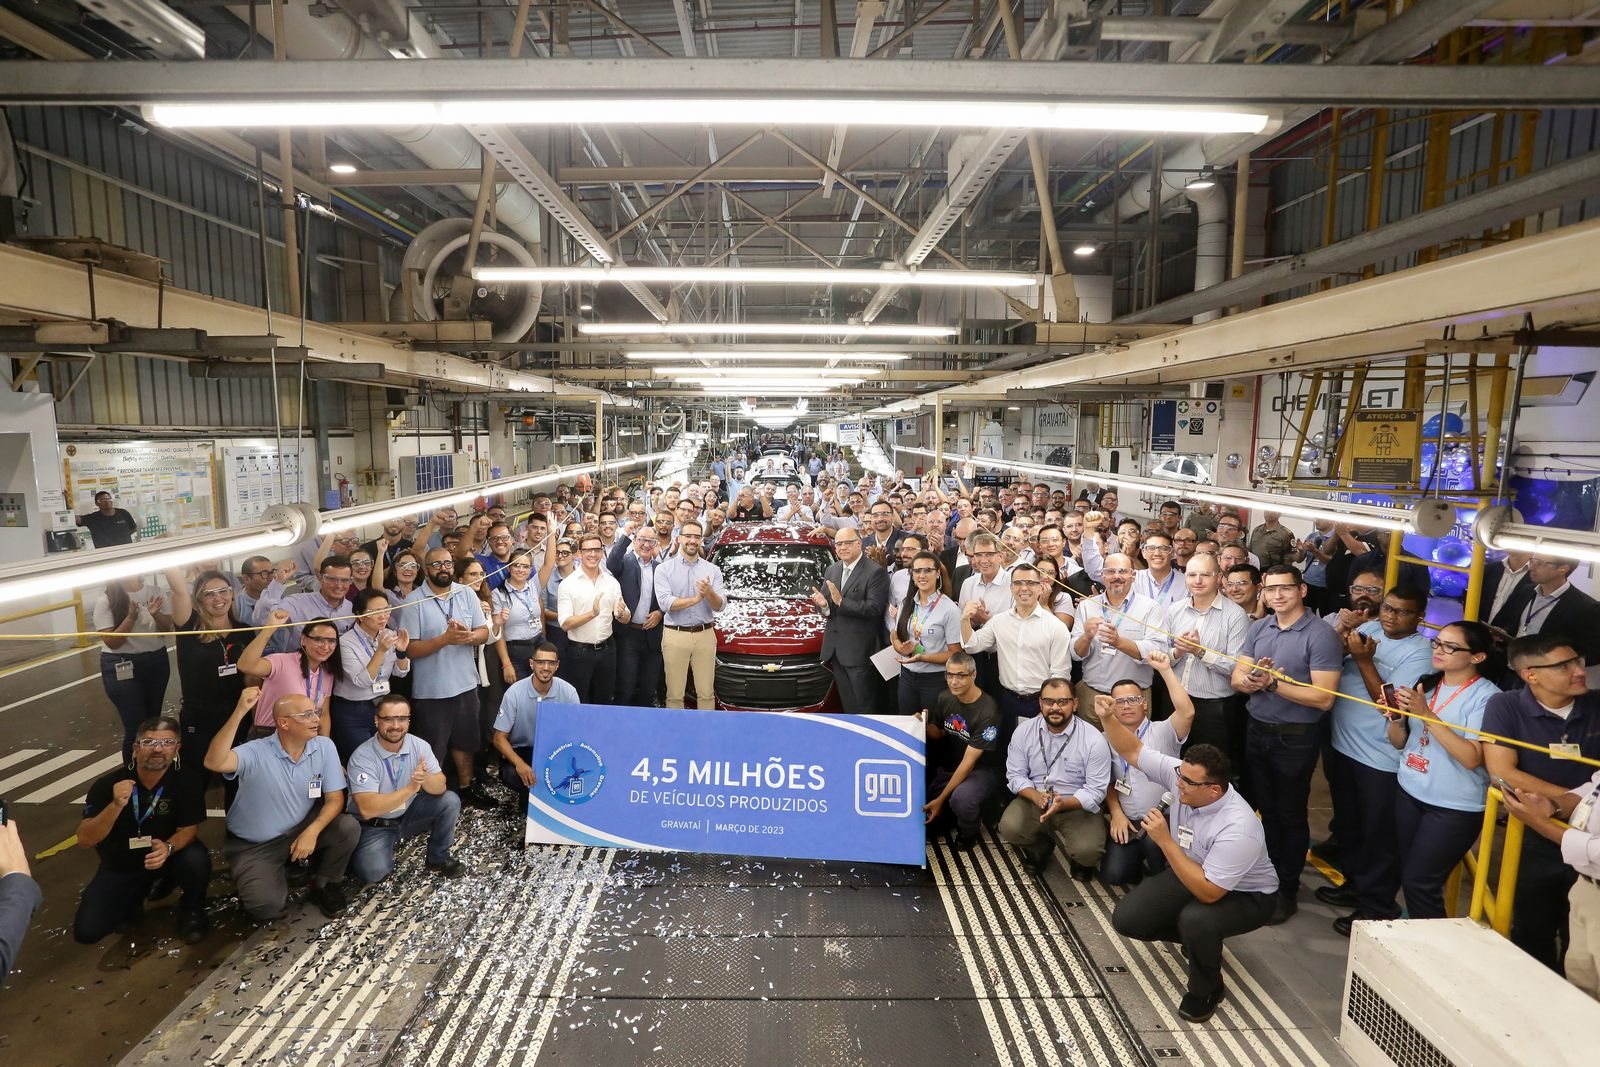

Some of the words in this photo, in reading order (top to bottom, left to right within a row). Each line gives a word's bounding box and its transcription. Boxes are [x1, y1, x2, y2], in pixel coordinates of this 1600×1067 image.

[1366, 413, 1407, 421] ATENÇÃO
[548, 742, 573, 761] Industrial
[580, 742, 603, 767] Automotivo
[630, 757, 678, 786] 4,5
[688, 756, 826, 791] MILHÕES
[865, 773, 902, 803] gm
[630, 790, 649, 804] DE
[653, 789, 725, 808] VEÍCULOS
[729, 795, 828, 813] PRODUZIDOS
[661, 819, 701, 830] GRAVATAÍ
[715, 823, 747, 834] MARÇO
[748, 825, 760, 834] DE
[762, 825, 785, 835] 2023
